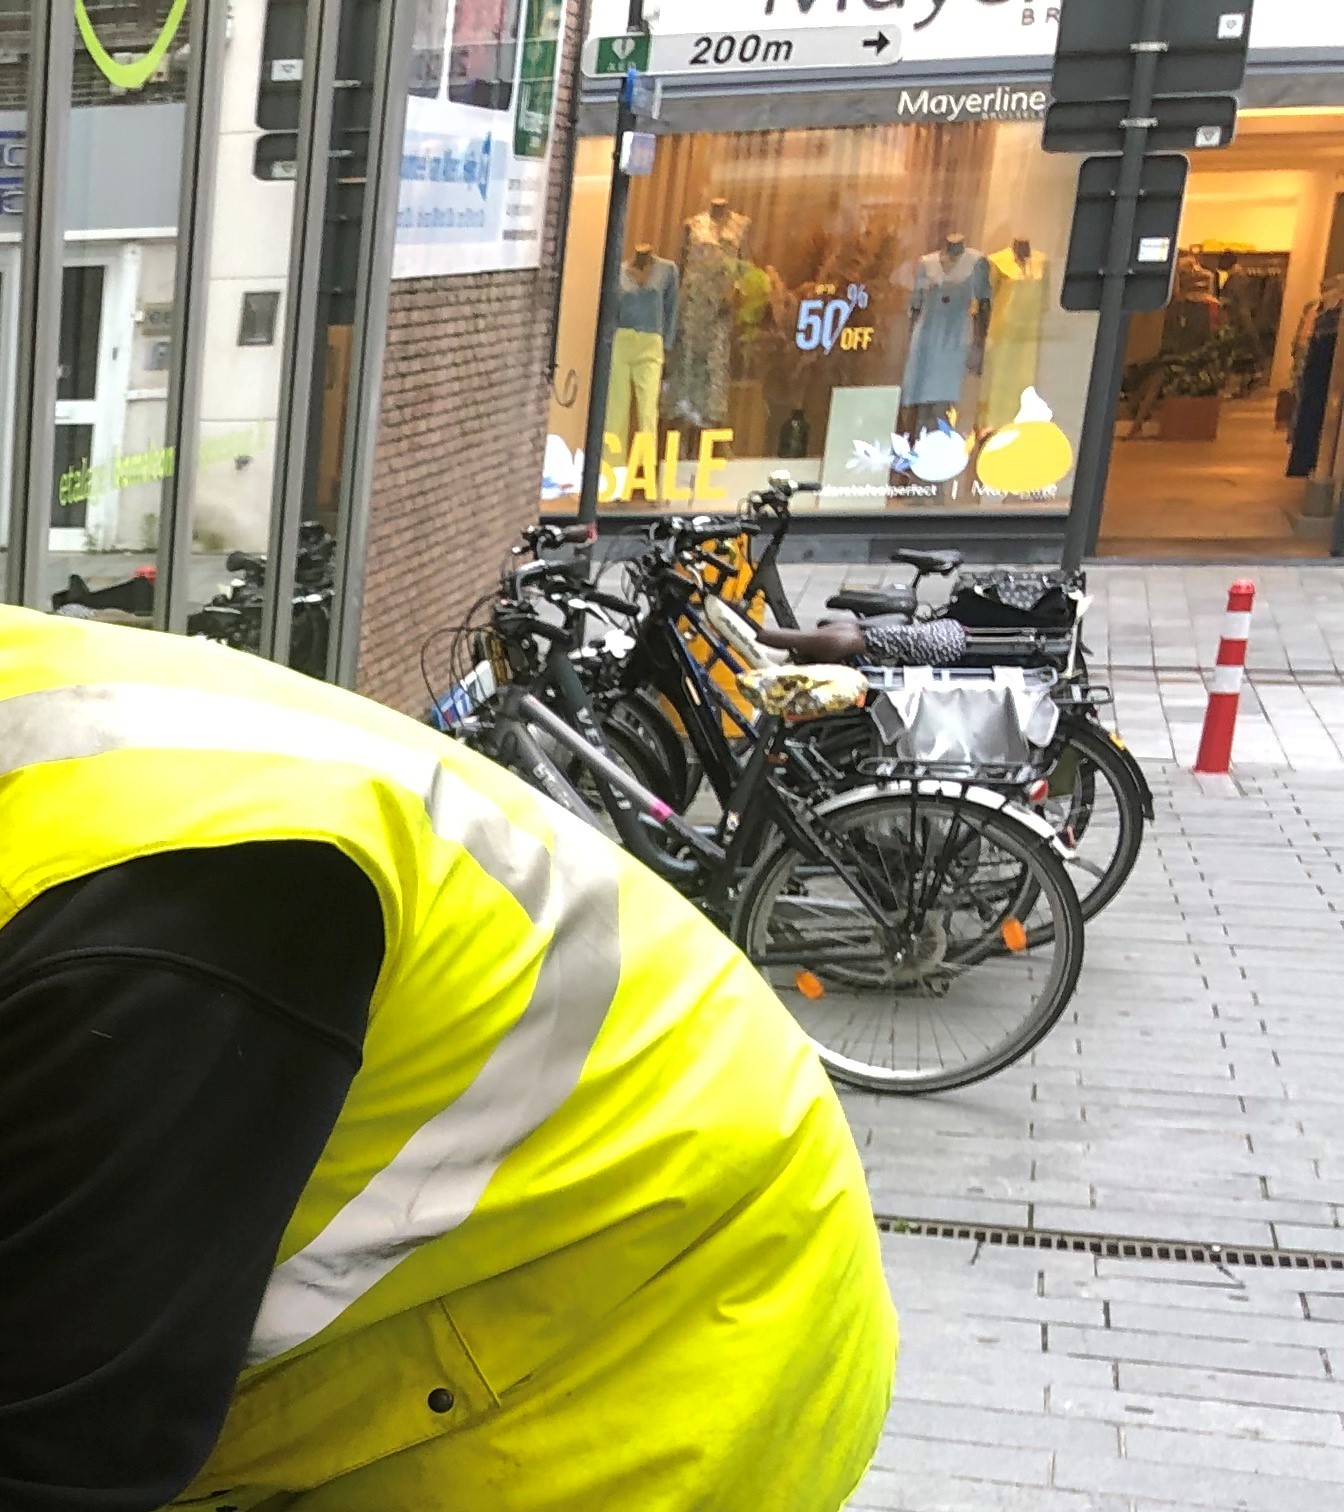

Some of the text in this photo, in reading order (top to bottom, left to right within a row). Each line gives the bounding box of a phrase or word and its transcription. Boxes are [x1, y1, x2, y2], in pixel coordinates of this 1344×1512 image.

[688, 33, 794, 66] 200m
[896, 85, 1047, 122] Mayerline
[795, 282, 869, 356] 50%
[839, 326, 875, 351] OFF
